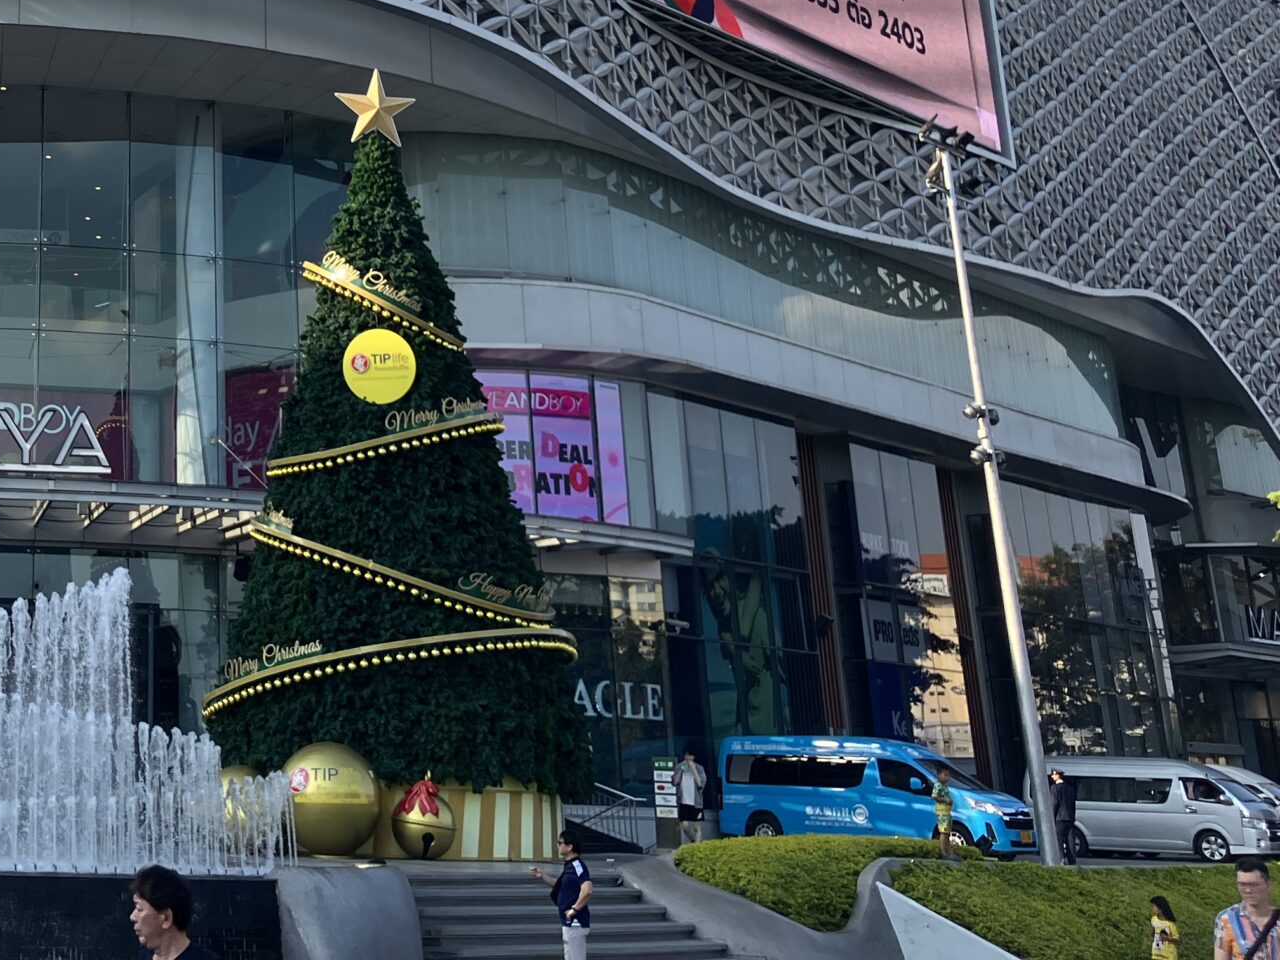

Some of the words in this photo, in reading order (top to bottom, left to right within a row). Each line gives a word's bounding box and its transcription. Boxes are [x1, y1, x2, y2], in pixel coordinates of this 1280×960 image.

[878, 10, 926, 55] 2403
[371, 353, 391, 365] TIP
[262, 640, 323, 668] Christmas
[311, 767, 340, 781] TIP
